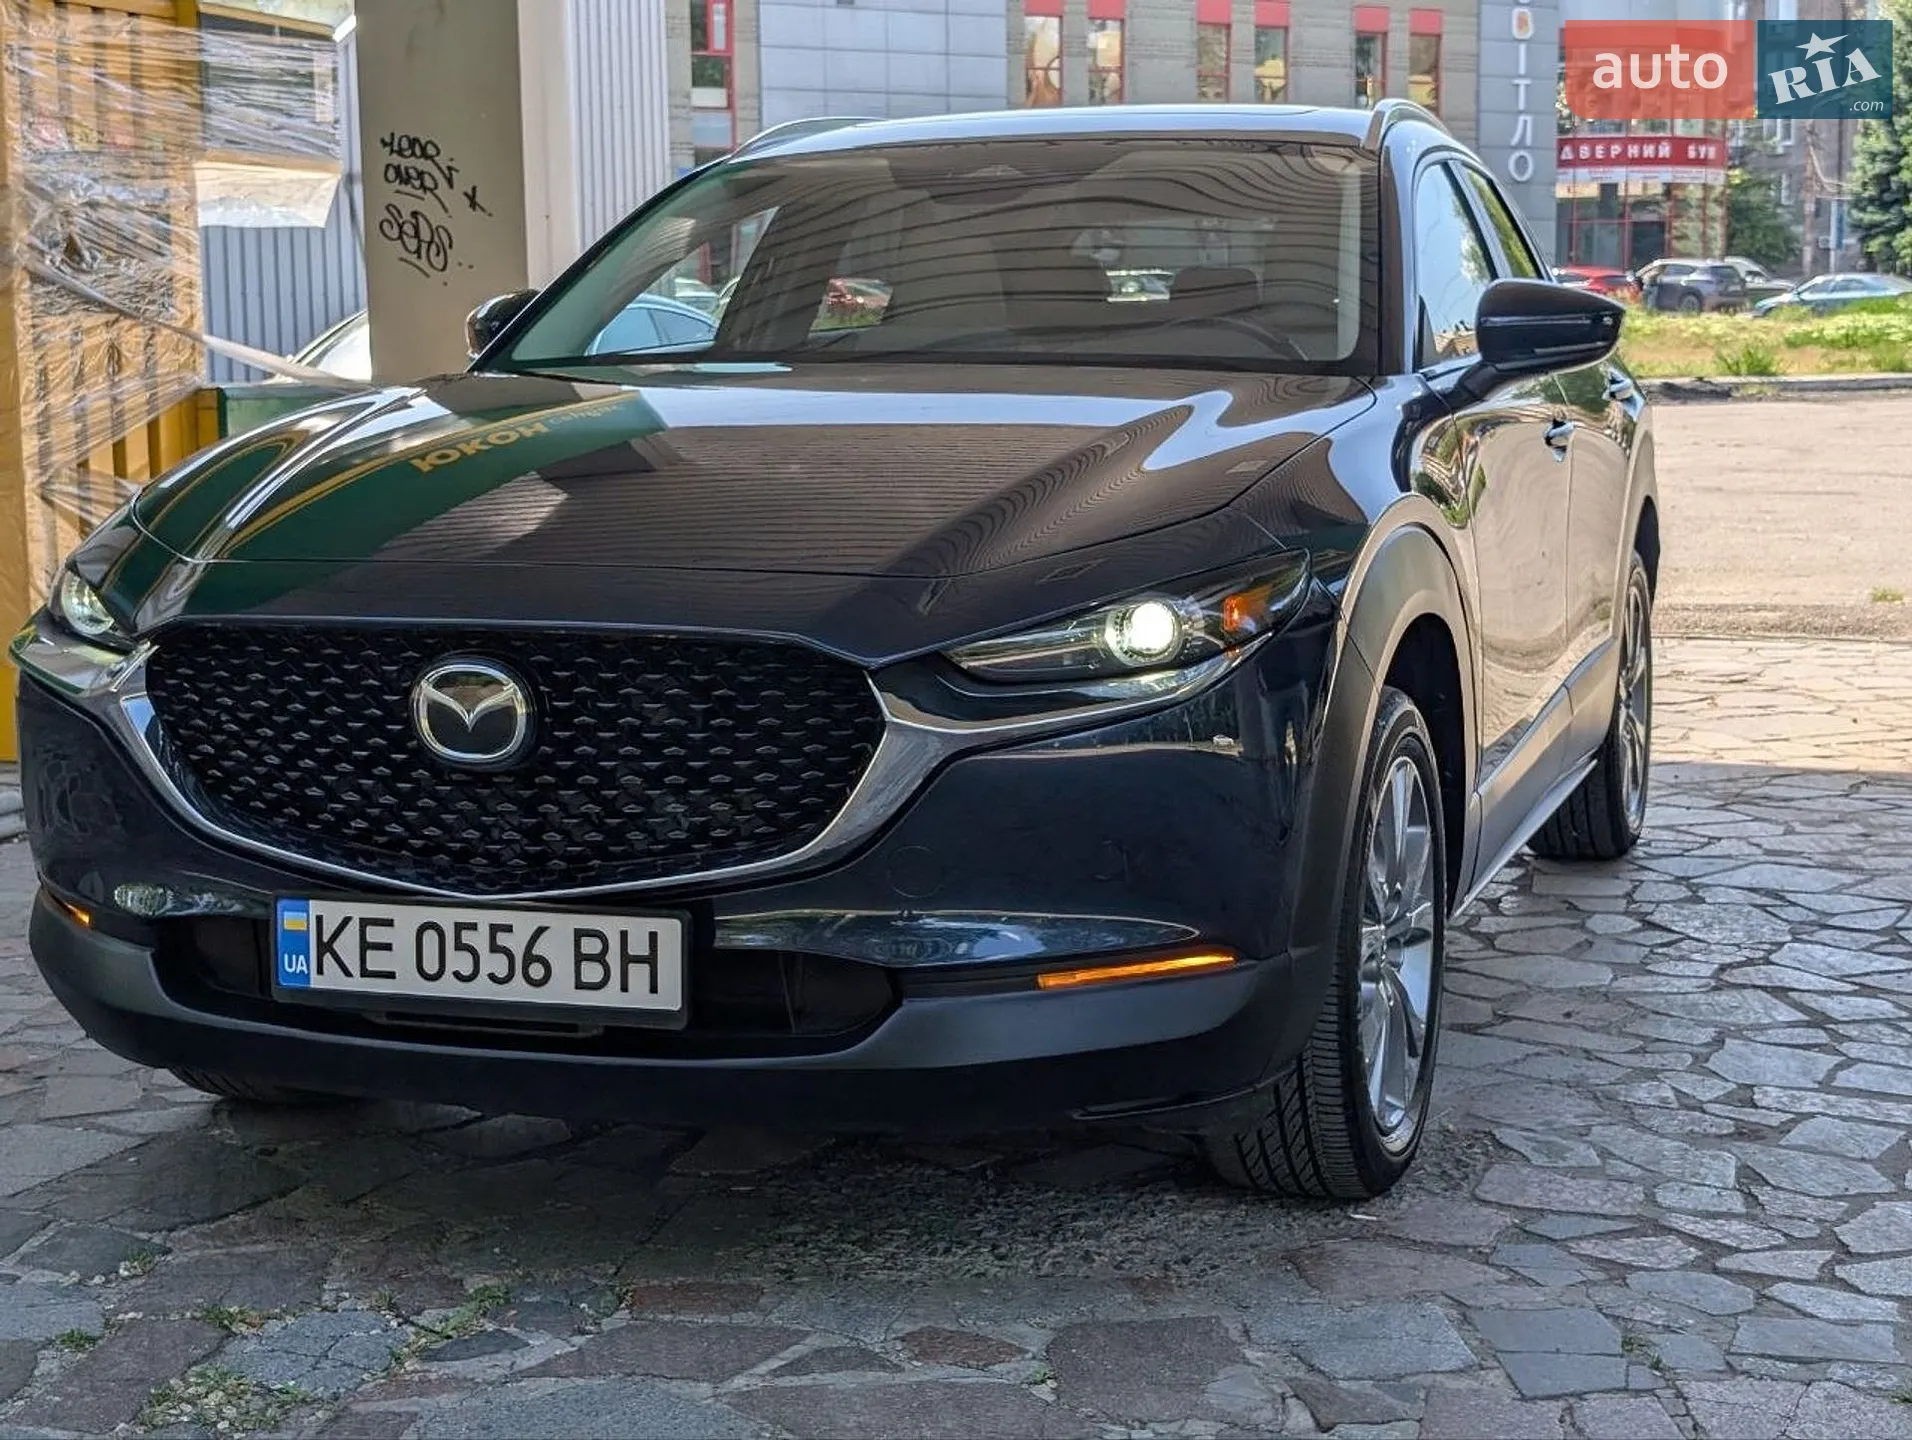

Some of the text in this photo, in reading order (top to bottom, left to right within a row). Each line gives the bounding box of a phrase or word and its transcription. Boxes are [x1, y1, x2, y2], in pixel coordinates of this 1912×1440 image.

[1508, 0, 1534, 182] ВІТЛО
[1560, 140, 1672, 161] ДВЕРНИЙ
[284, 953, 309, 975] UA
[315, 914, 659, 994] KE 0556 BH
